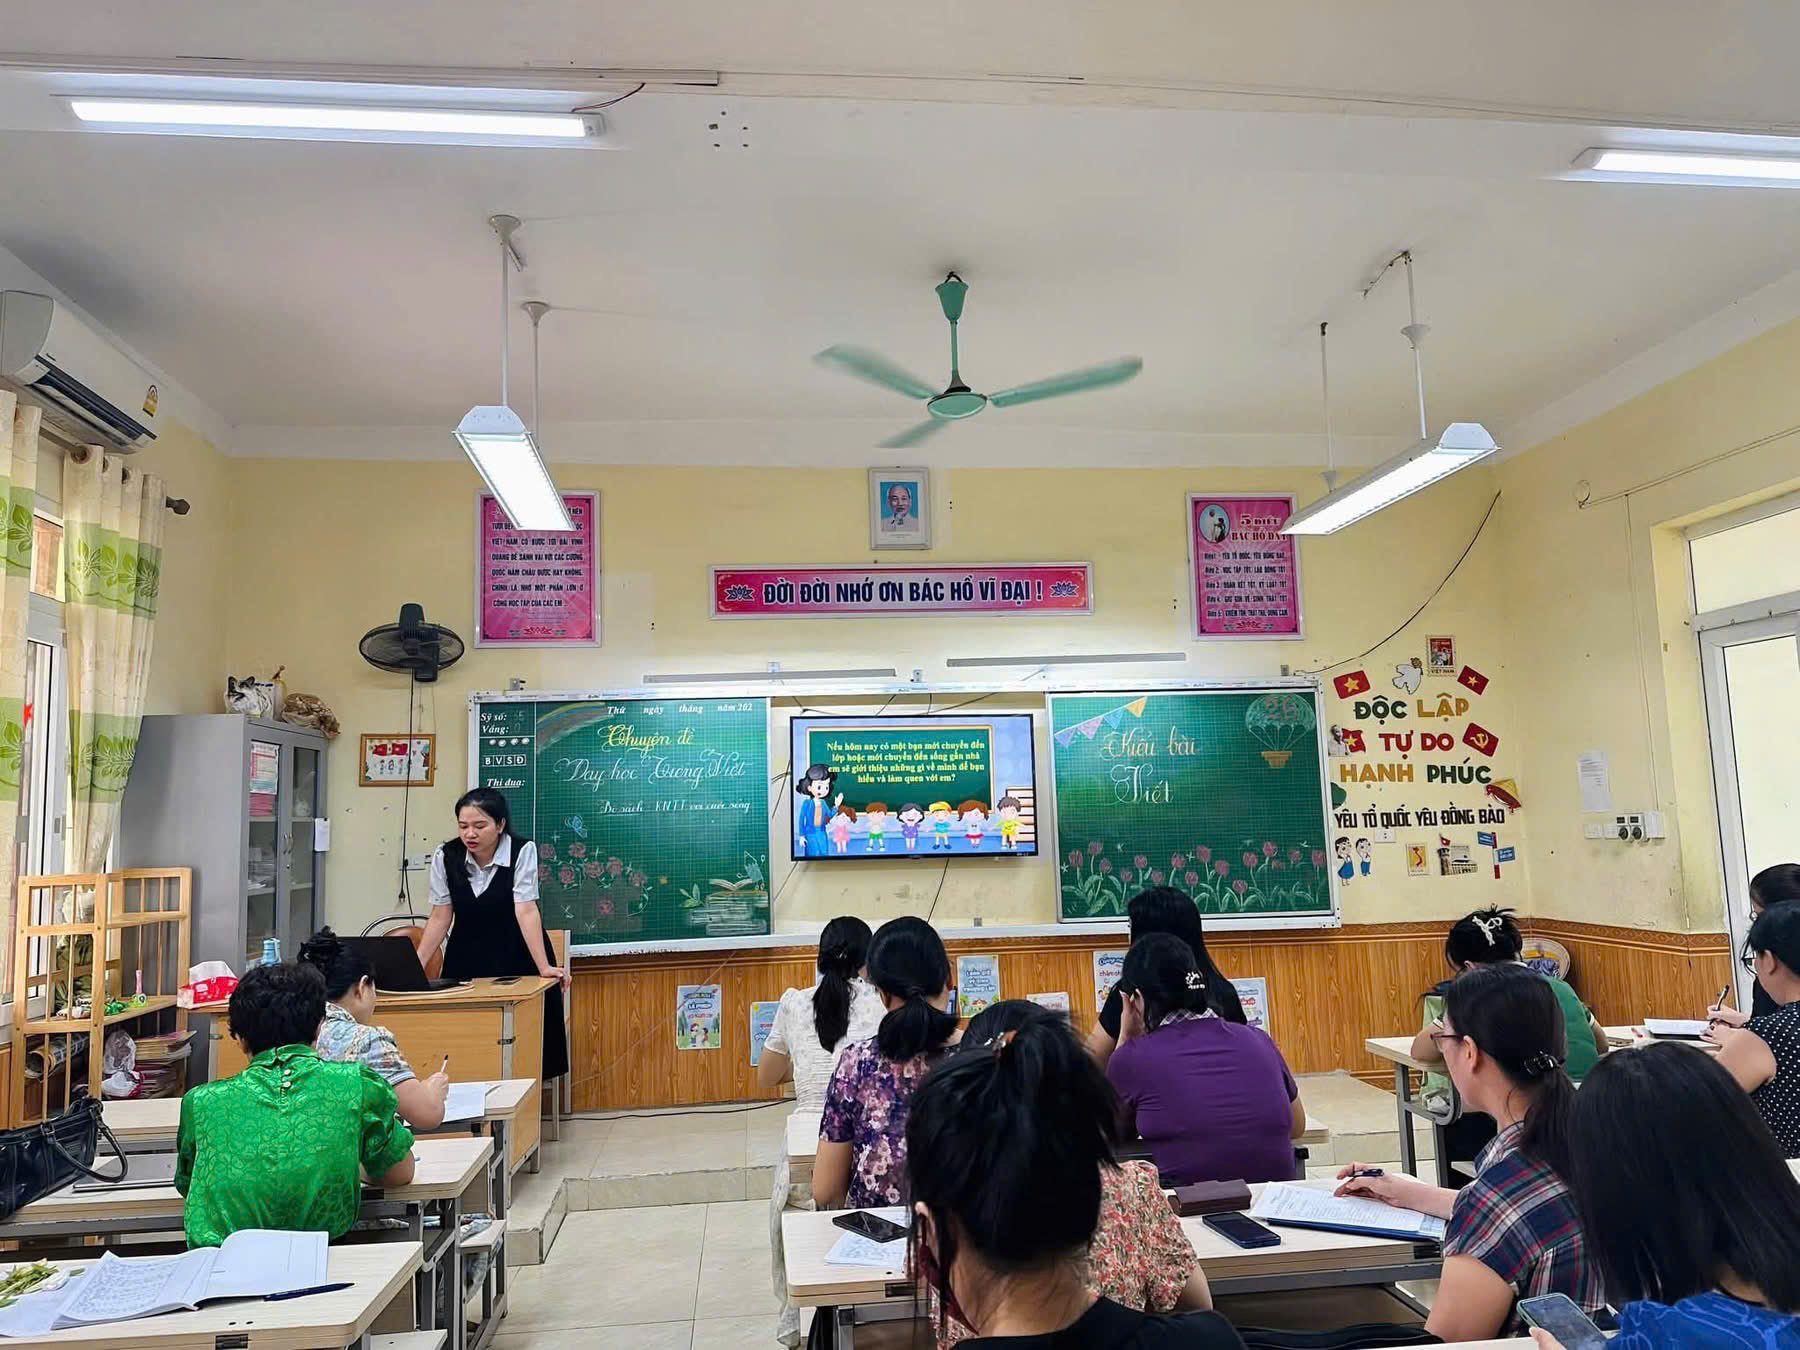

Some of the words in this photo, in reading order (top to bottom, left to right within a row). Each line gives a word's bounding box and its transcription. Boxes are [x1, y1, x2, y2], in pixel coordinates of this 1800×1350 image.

[764, 579, 794, 604] ĐỜI
[800, 578, 830, 603] ĐỜI
[836, 576, 874, 602] NHỚ
[878, 581, 904, 602] ƠN
[909, 577, 944, 602] BÁC
[950, 574, 975, 601] HỒ
[978, 576, 996, 600] VĨ
[1001, 579, 1030, 605] ĐẠI
[480, 712, 491, 722] Sỹ
[494, 712, 507, 720] số:
[607, 706, 626, 714] Thứ
[643, 706, 664, 715] ngày
[679, 704, 704, 713] tháng
[1353, 695, 1408, 725] ĐỘC
[1416, 692, 1469, 722] LẬP
[1168, 726, 1196, 756] bài
[1378, 730, 1414, 760] TỰ
[1421, 733, 1454, 751] DO
[1340, 764, 1414, 788] HẠNH
[1427, 757, 1492, 784] PHÚC
[1334, 808, 1357, 828] YÊU
[1362, 804, 1377, 827] TỔ
[1380, 804, 1412, 830] QUỐC
[1415, 808, 1438, 826] YÊU
[1441, 801, 1475, 825] ĐỒNG
[1478, 804, 1505, 824] BÀO
